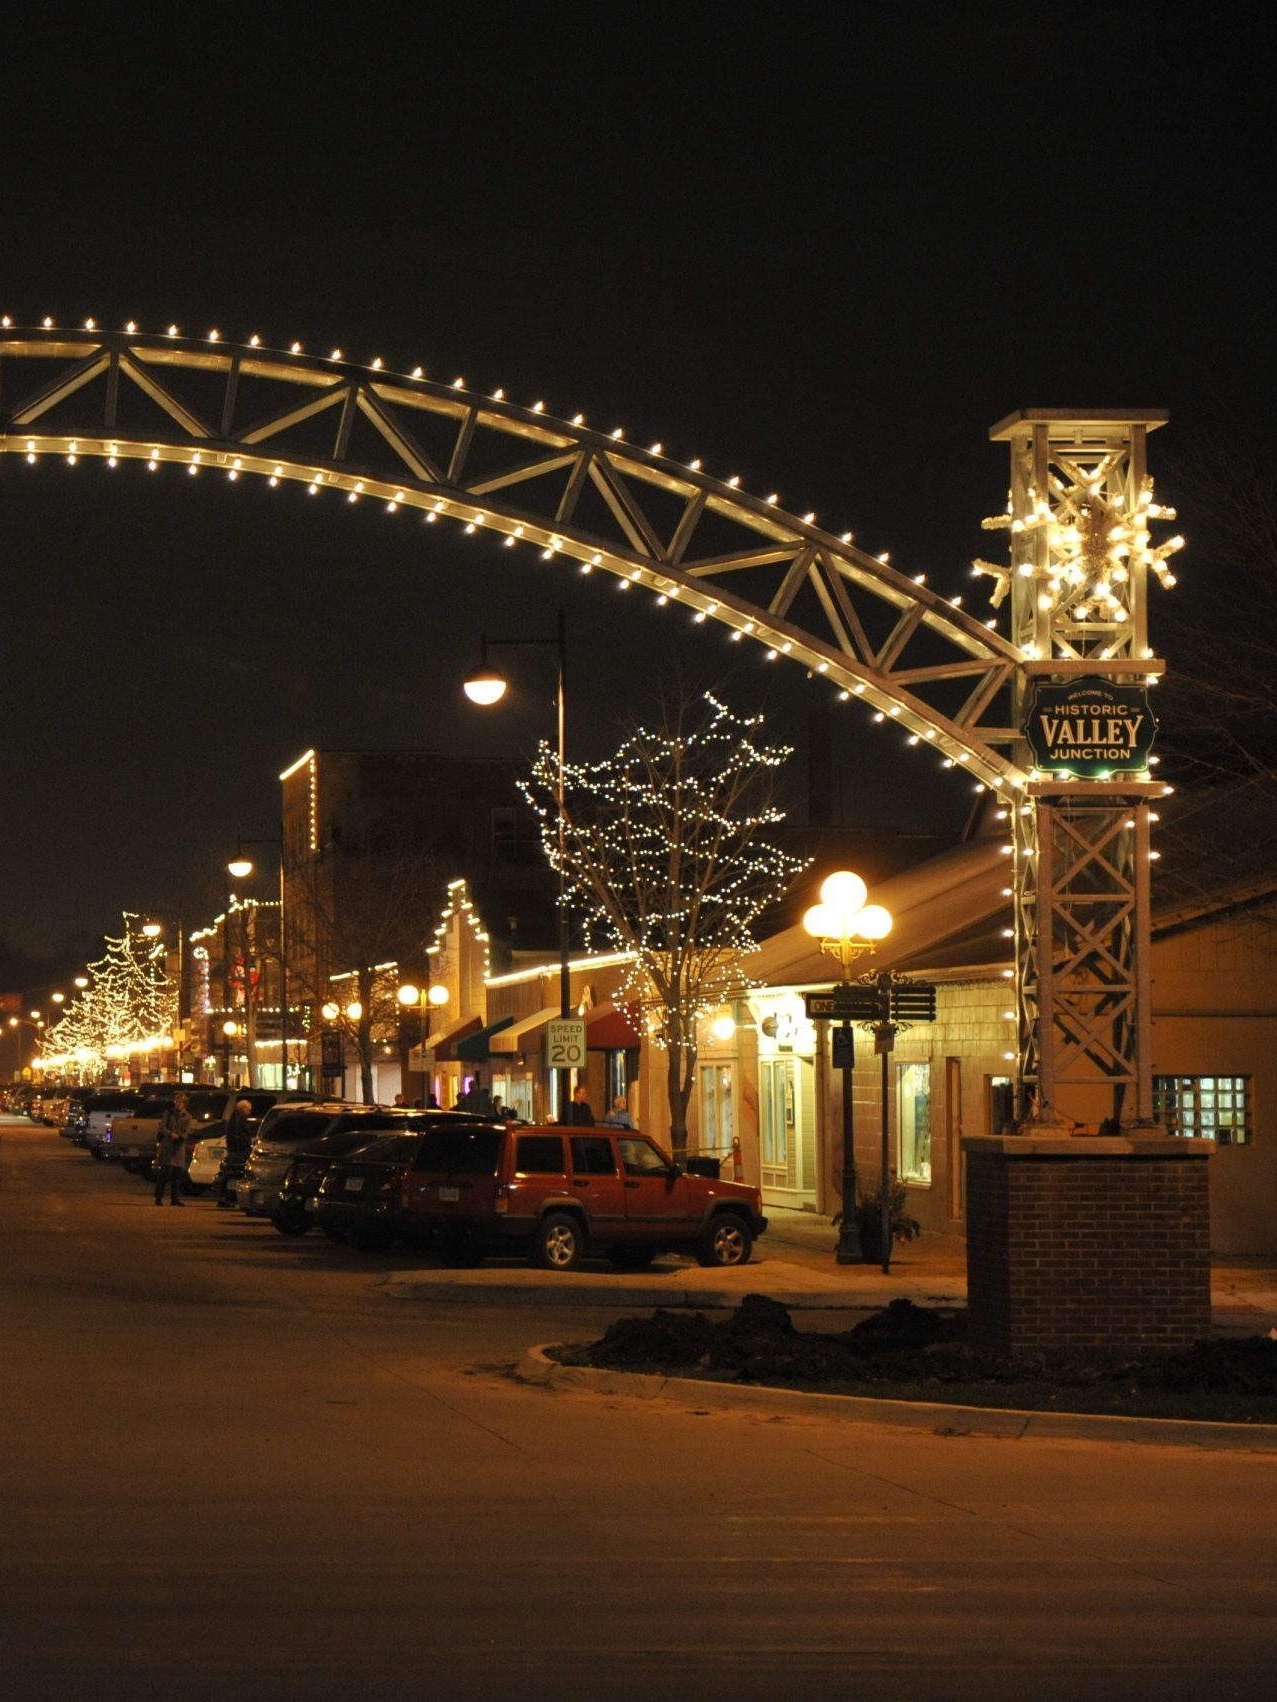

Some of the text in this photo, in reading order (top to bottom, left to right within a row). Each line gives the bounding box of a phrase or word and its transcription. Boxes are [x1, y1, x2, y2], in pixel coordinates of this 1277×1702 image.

[1067, 689, 1102, 700] WELCOME
[1055, 704, 1128, 715] HISTORIC
[1040, 715, 1144, 747] VALLEY
[1050, 749, 1131, 759] JUNCTION
[814, 1001, 835, 1011] ONE
[552, 1045, 581, 1062] 20
